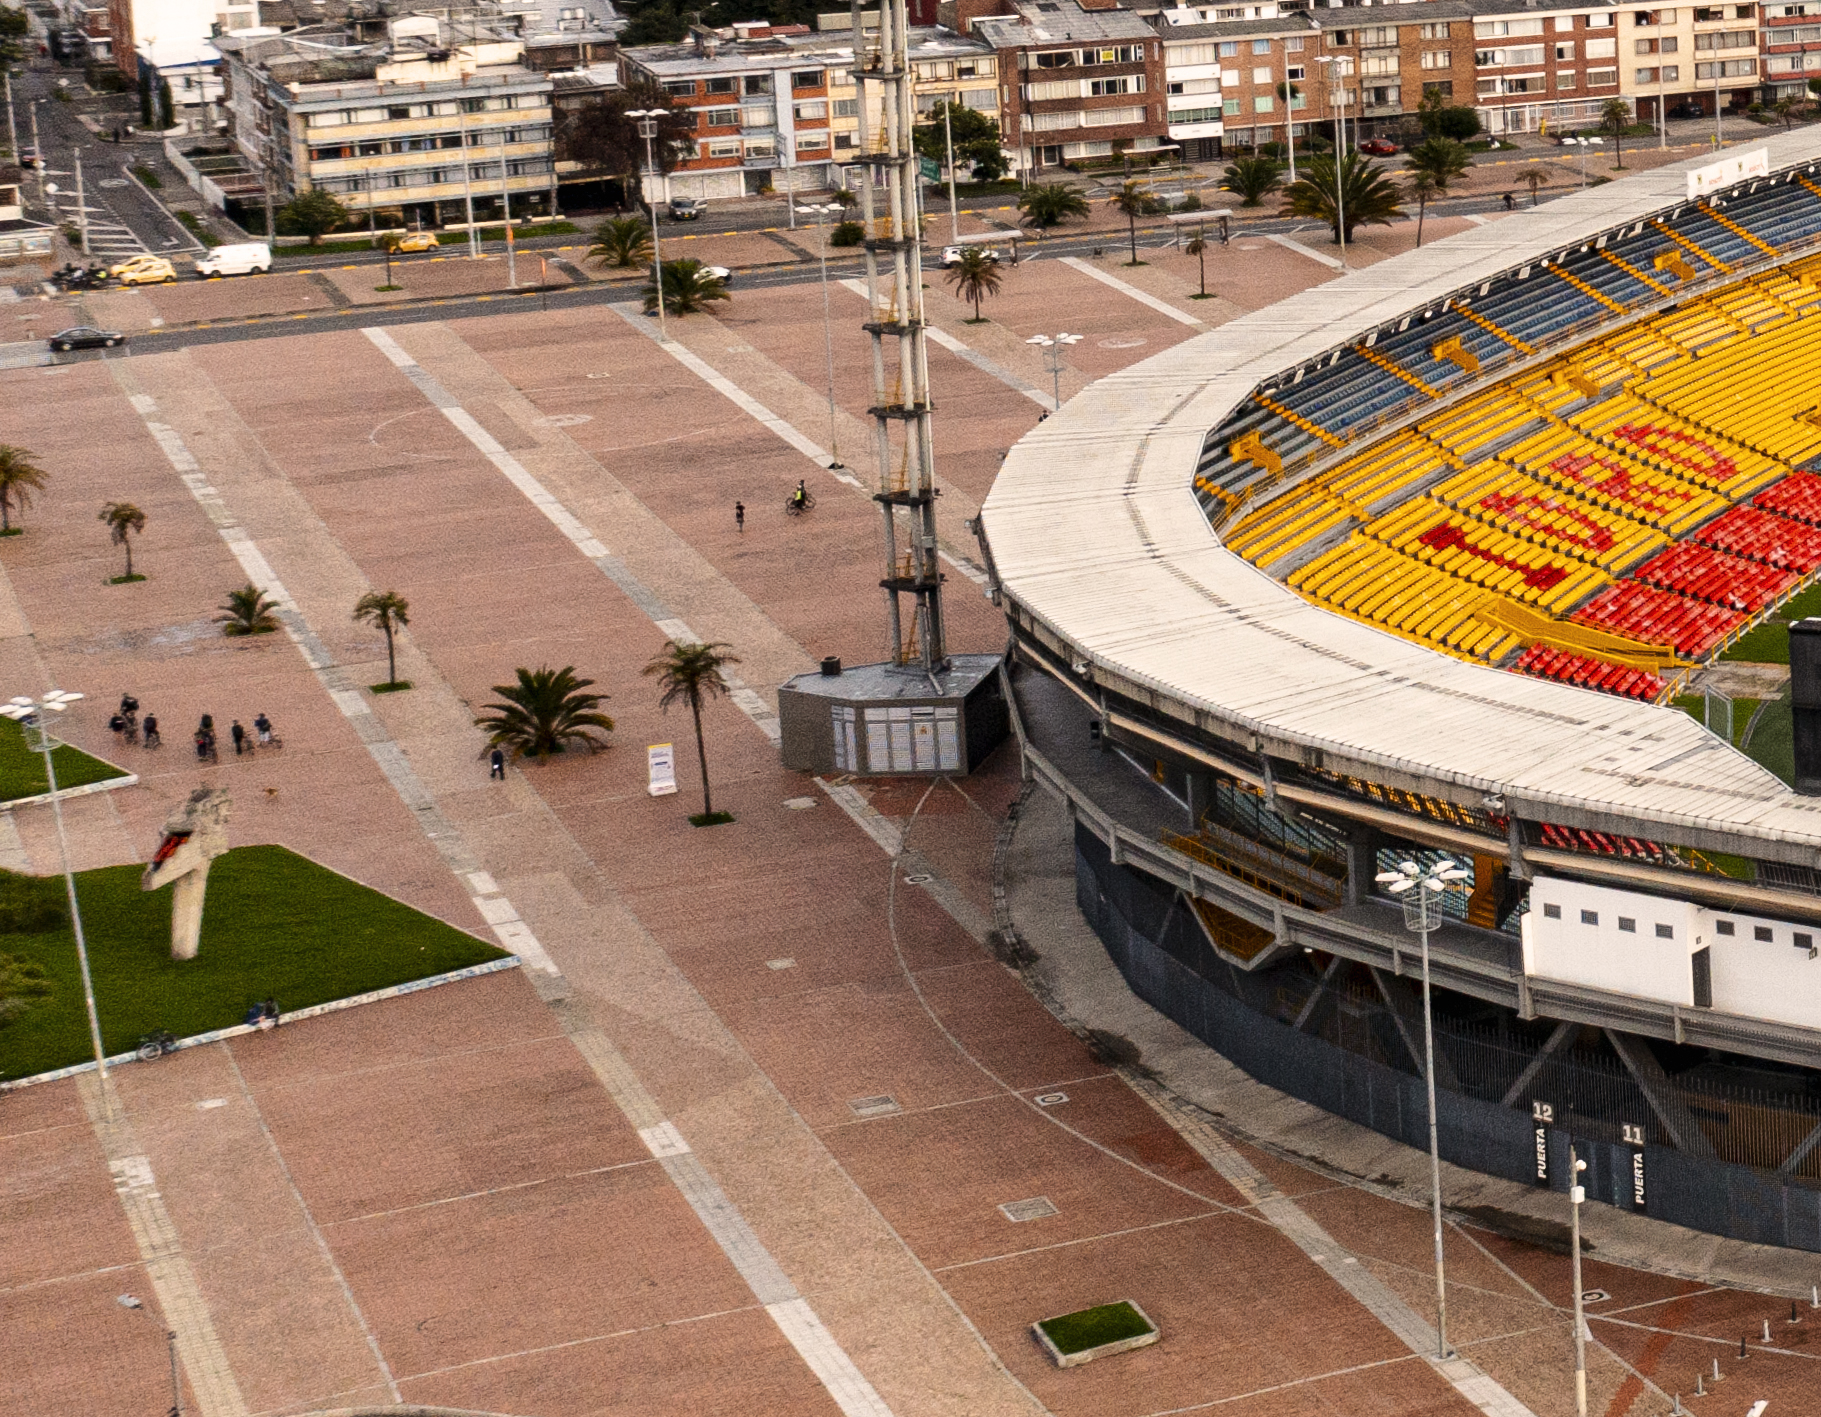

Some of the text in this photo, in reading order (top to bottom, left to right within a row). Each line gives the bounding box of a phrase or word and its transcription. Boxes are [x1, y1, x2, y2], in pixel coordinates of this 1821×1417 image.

[1533, 1102, 1553, 1122] 12
[1623, 1125, 1644, 1144] 11
[1536, 1128, 1547, 1179] PUERTA
[1634, 1152, 1645, 1204] PUERTA
